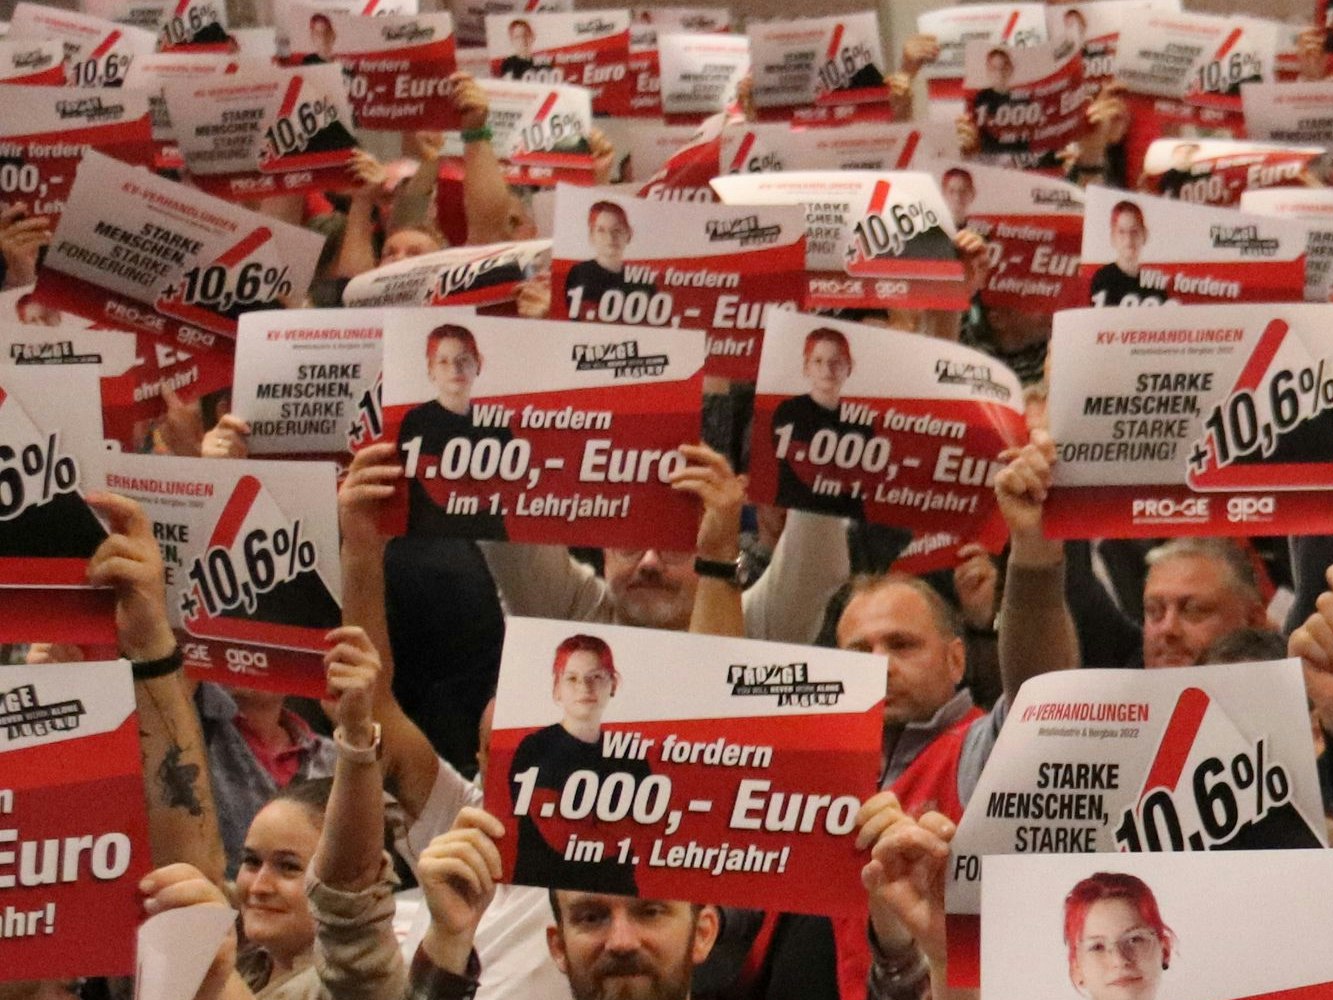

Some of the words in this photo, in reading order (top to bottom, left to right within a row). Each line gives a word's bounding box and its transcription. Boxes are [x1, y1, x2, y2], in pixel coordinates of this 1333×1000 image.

[94, 221, 186, 268] MENSCHEN,
[139, 222, 204, 256] STARKE
[56, 240, 158, 286] FORDERUNG!
[161, 261, 292, 310] +10,6%
[567, 286, 702, 330] 1.000,-
[1096, 328, 1244, 345] KV-VERHANDLUNGEN
[298, 364, 362, 380] STARKE
[1136, 373, 1214, 393] STARKE
[472, 404, 513, 428] Wir
[521, 404, 613, 430] fordern
[839, 401, 876, 427] Wir
[883, 407, 967, 440] fordern
[1084, 395, 1201, 417] MENSCHEN,
[1113, 418, 1188, 440] STARKE
[401, 436, 565, 490] 1.000,-
[579, 438, 688, 484] Euro
[773, 425, 920, 479] 1.000,-
[1054, 441, 1177, 464] FORDERUNG!
[516, 493, 631, 522] Lehrjahr!
[874, 483, 978, 516] Lehrjahr!
[1227, 497, 1274, 523] gpa
[181, 520, 315, 622] +10,6%
[1021, 703, 1150, 723] KV-VERHANDLUNGEN
[601, 729, 654, 761] Wir
[661, 735, 774, 769] fordern
[1037, 763, 1119, 790] STARKE
[511, 766, 712, 837] 1.000,-
[730, 779, 862, 836] Euro
[987, 793, 1109, 826] MENSCHEN,
[564, 835, 604, 863] im
[616, 837, 641, 866] 1.
[650, 839, 791, 877] Lehrjahr!
[1015, 826, 1097, 853] STARKE
[0, 830, 132, 888] Euro
